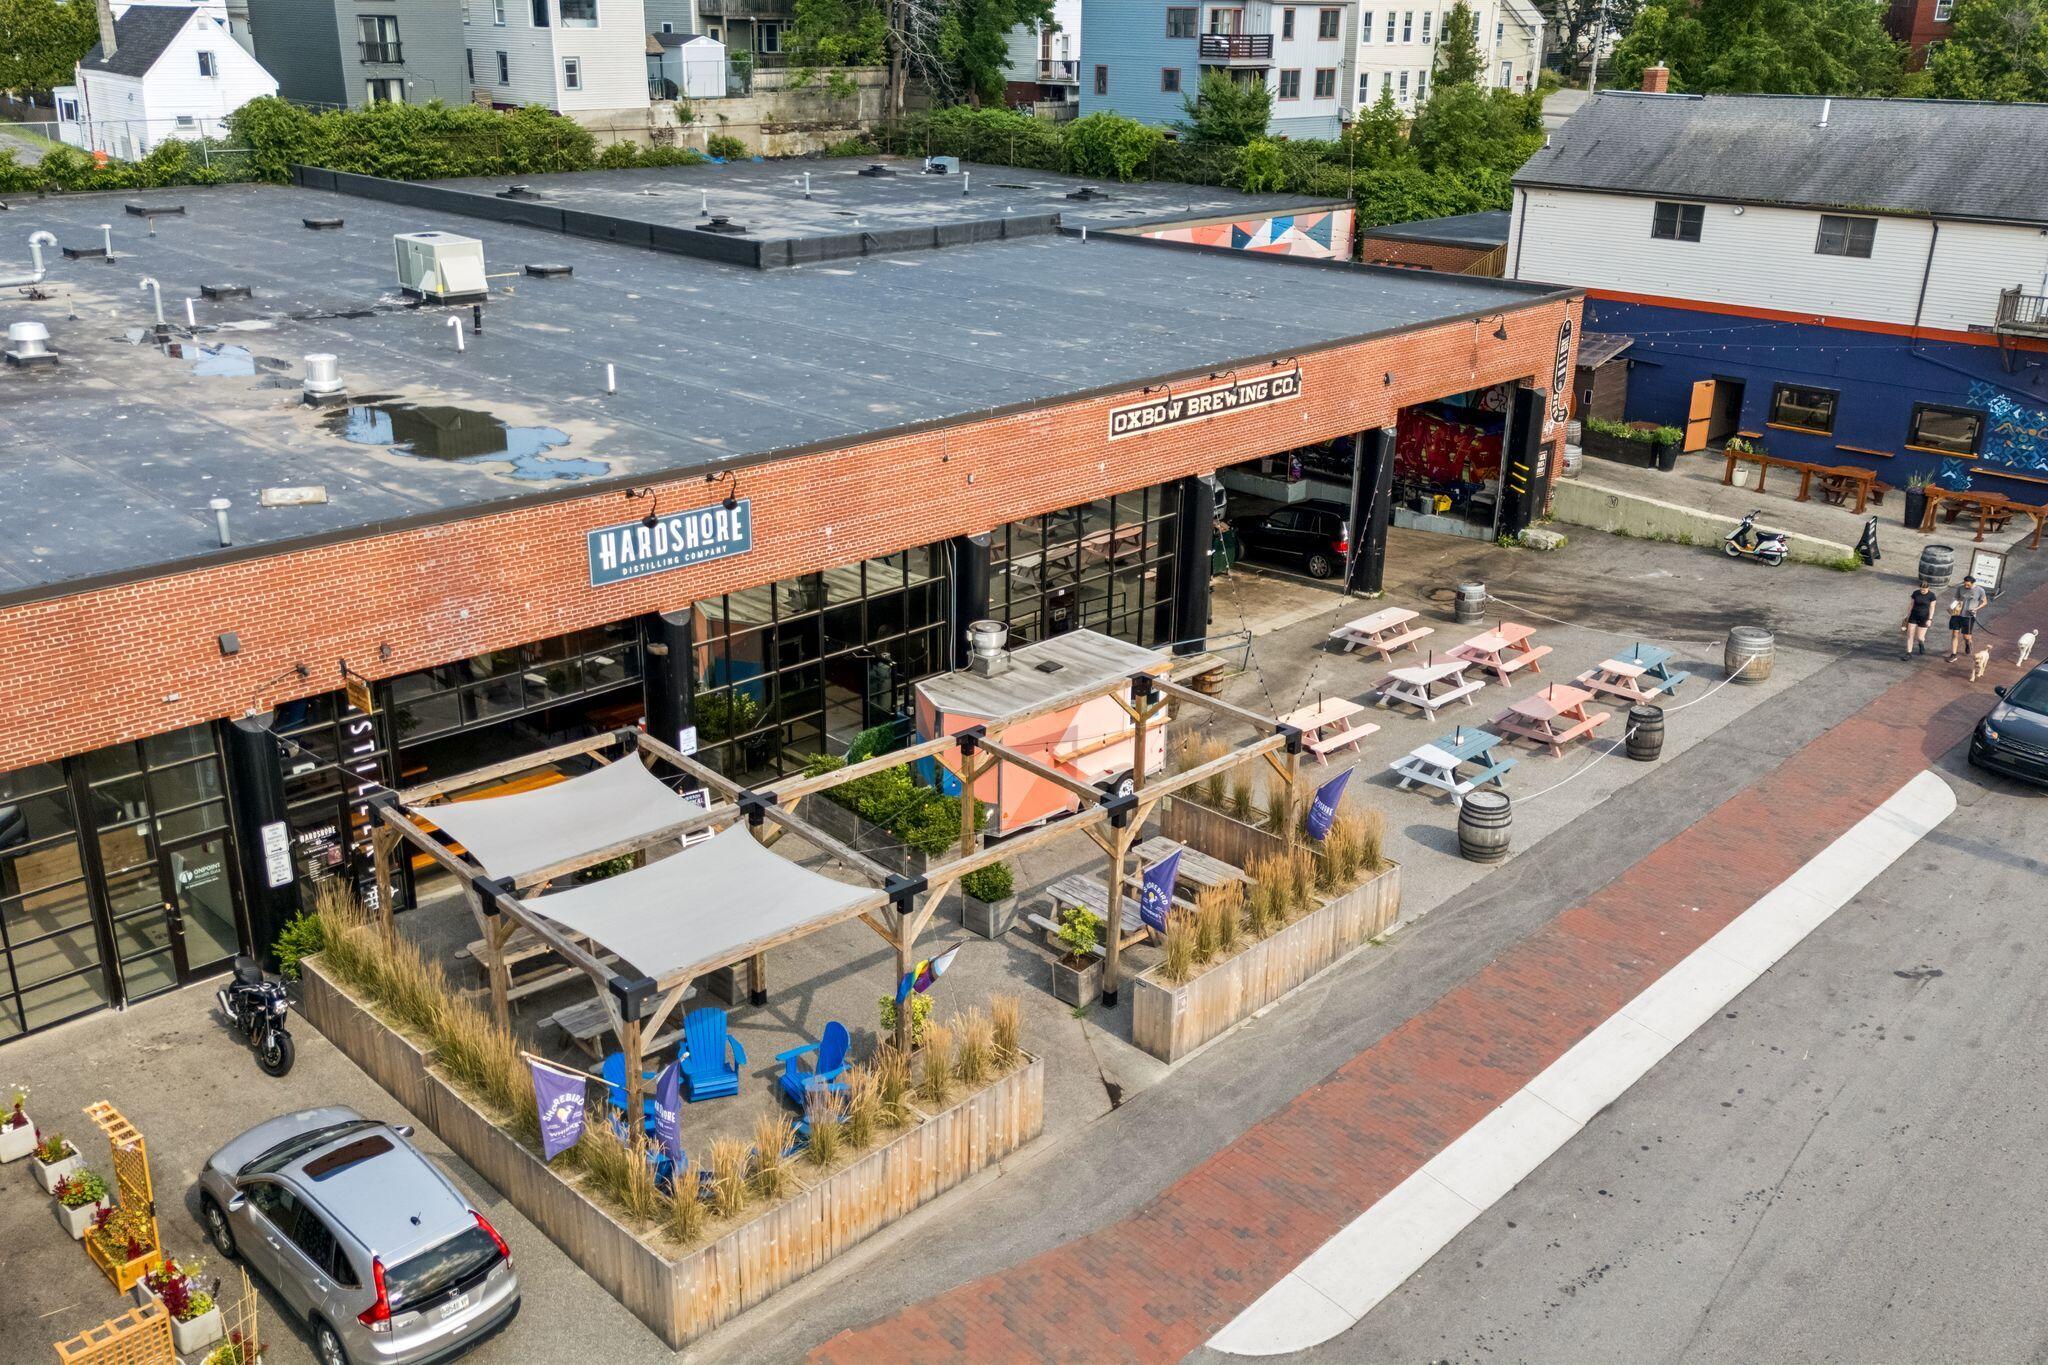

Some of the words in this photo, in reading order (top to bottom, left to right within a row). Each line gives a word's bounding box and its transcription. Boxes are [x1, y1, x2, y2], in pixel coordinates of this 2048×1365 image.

[1114, 400, 1183, 432] OXBOW
[1187, 382, 1268, 416] BREWING
[1272, 377, 1298, 397] CO.
[599, 506, 743, 570] HARDSHORE
[622, 555, 680, 576] DISTILLING
[684, 545, 727, 562] COMPANY
[193, 862, 221, 875] ONPOINT
[542, 1093, 585, 1122] SHOREBIRD
